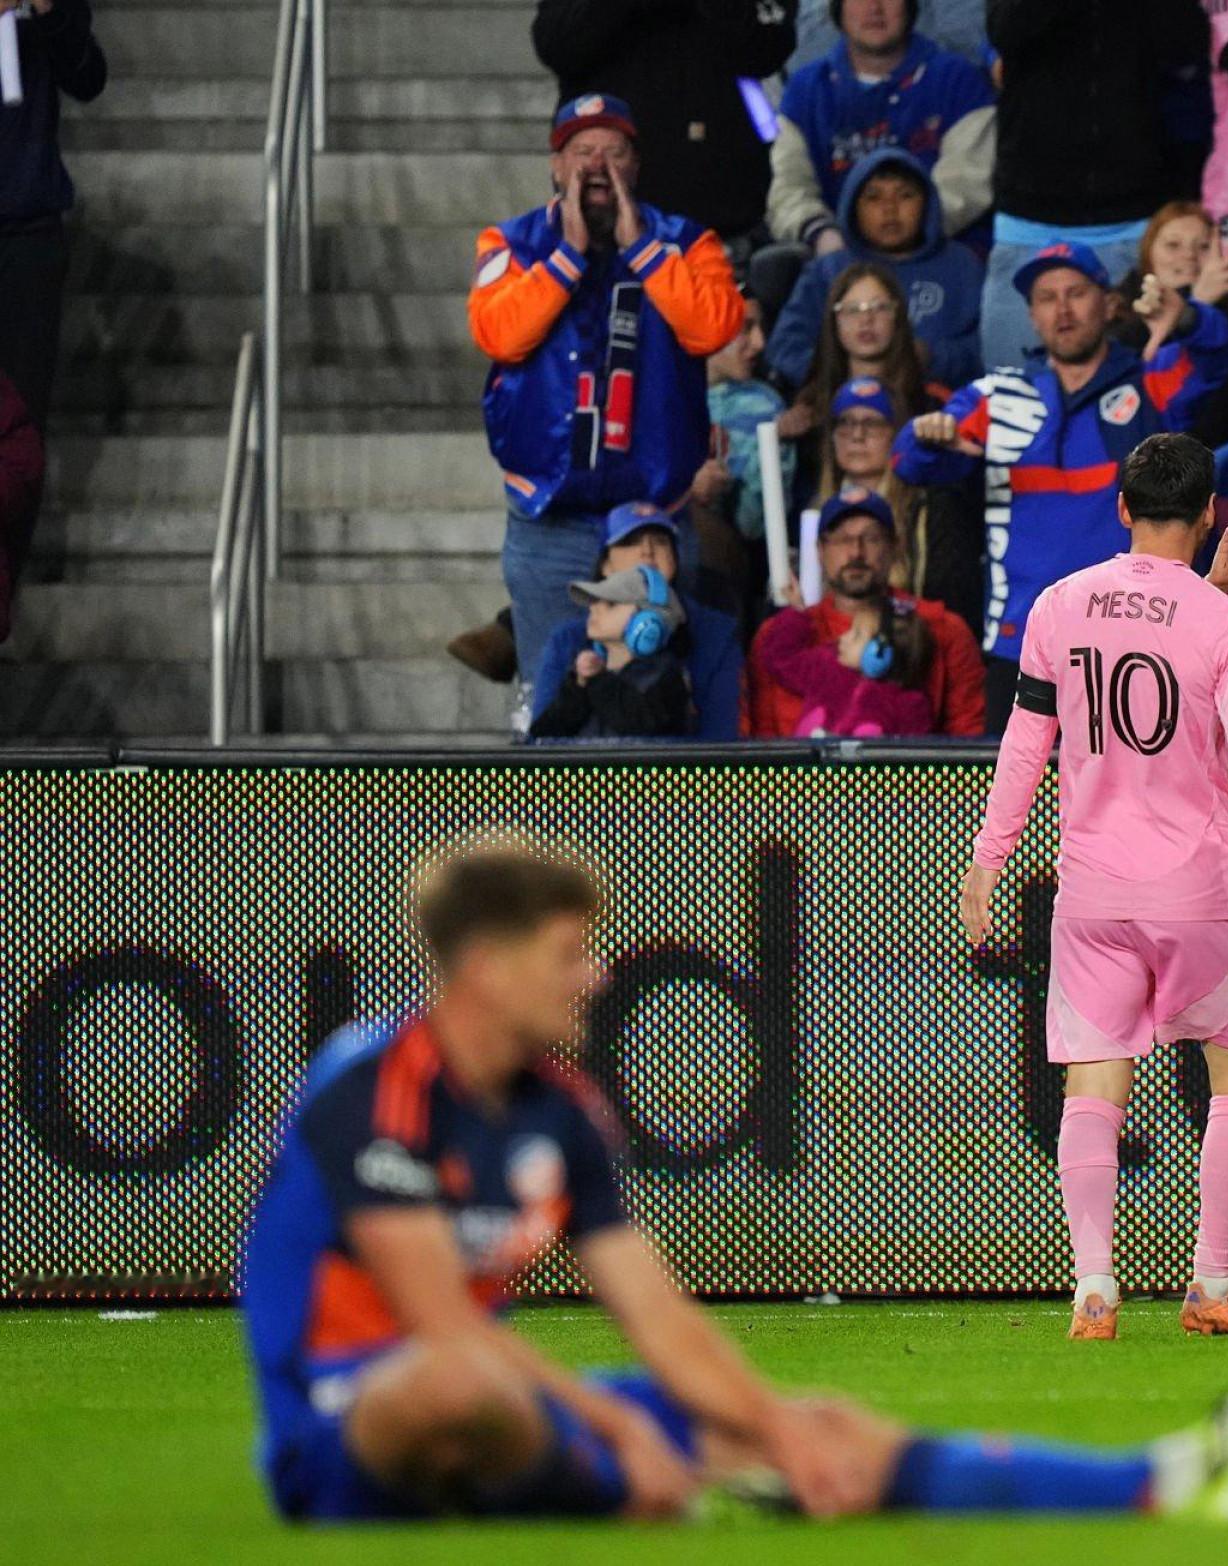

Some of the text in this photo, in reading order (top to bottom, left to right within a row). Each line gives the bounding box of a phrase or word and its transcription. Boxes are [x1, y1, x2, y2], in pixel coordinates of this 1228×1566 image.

[1086, 590, 1178, 628] MESSI
[1069, 646, 1180, 756] 10
[16, 838, 802, 1178] od
